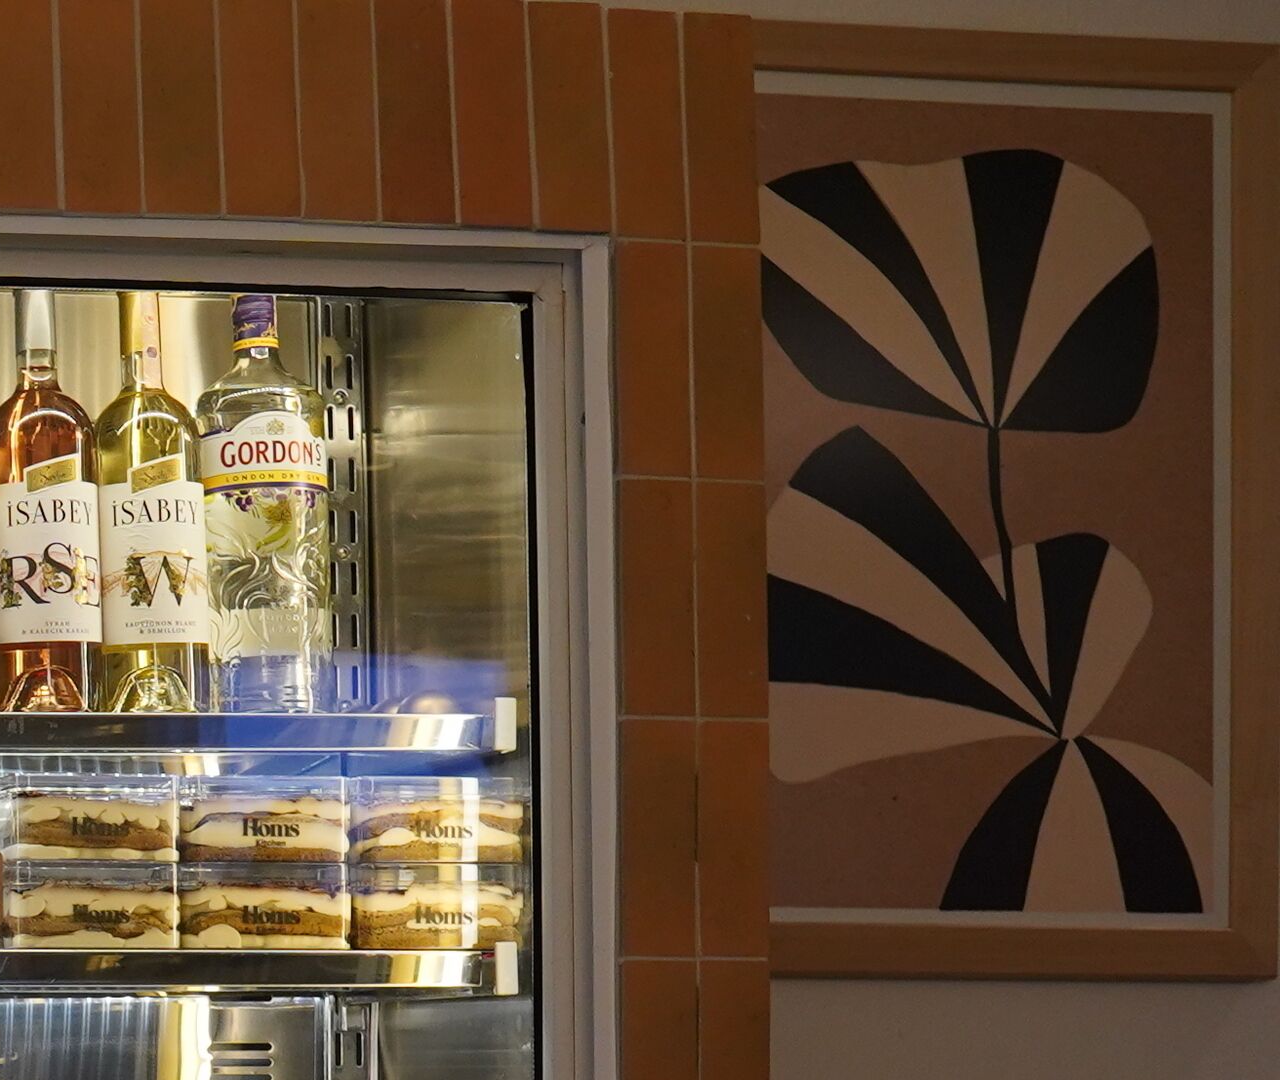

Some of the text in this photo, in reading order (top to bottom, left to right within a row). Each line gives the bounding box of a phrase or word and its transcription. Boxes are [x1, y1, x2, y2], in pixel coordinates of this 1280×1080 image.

[220, 440, 322, 468] GORDON'S
[226, 472, 276, 483] LONDON
[71, 817, 129, 837] Homs
[242, 818, 301, 838] Homs
[415, 819, 473, 839] Homs
[255, 839, 287, 847] Kitchen
[72, 904, 130, 923] Homs
[242, 905, 301, 924] Homs
[415, 906, 473, 925] Homs
